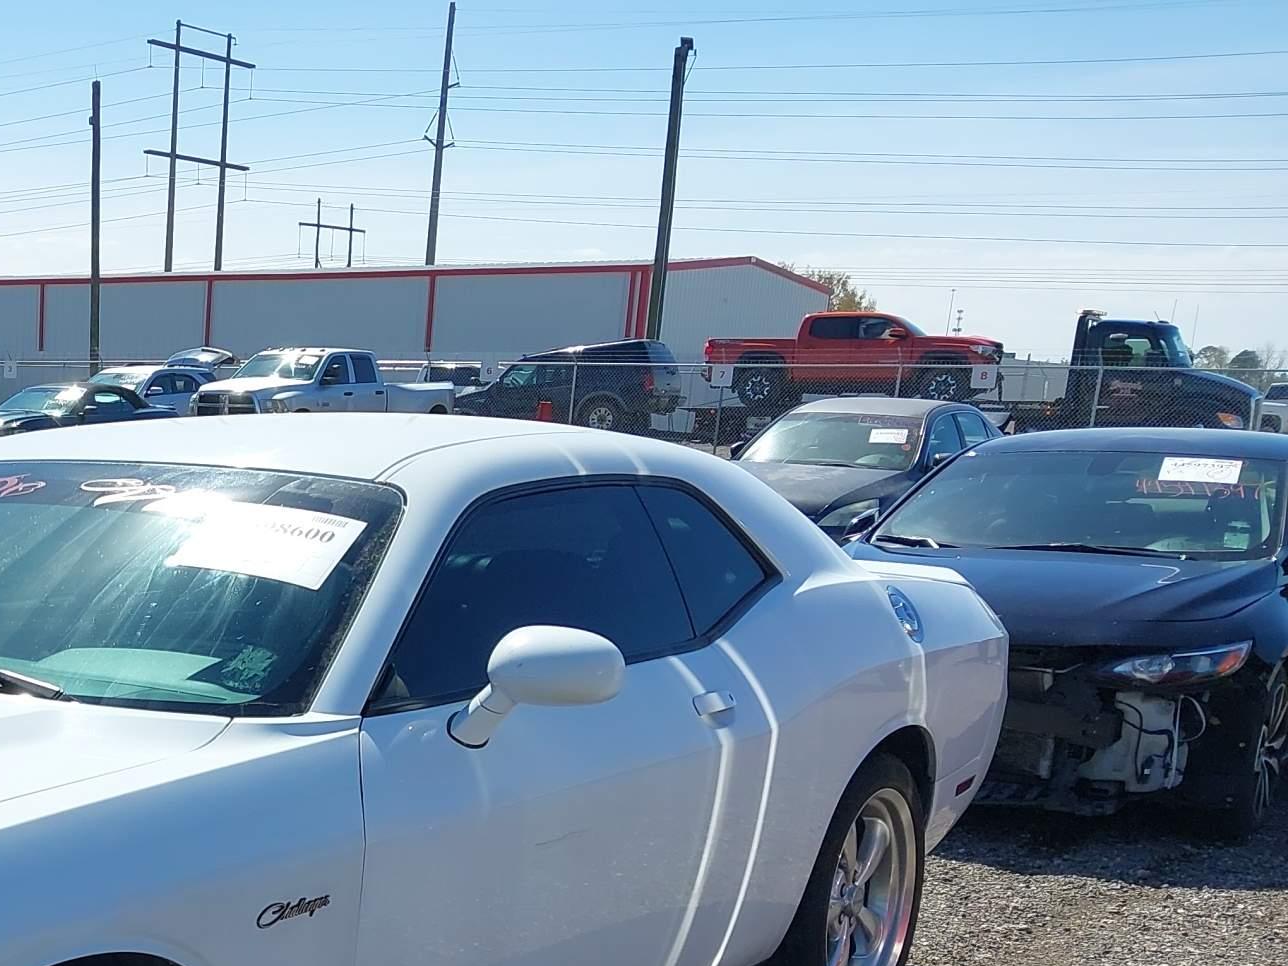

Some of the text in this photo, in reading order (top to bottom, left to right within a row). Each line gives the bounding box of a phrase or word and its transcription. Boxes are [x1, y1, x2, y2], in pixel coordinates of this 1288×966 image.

[486, 367, 494, 375] 6
[719, 370, 726, 379] 7
[980, 371, 988, 380] 8
